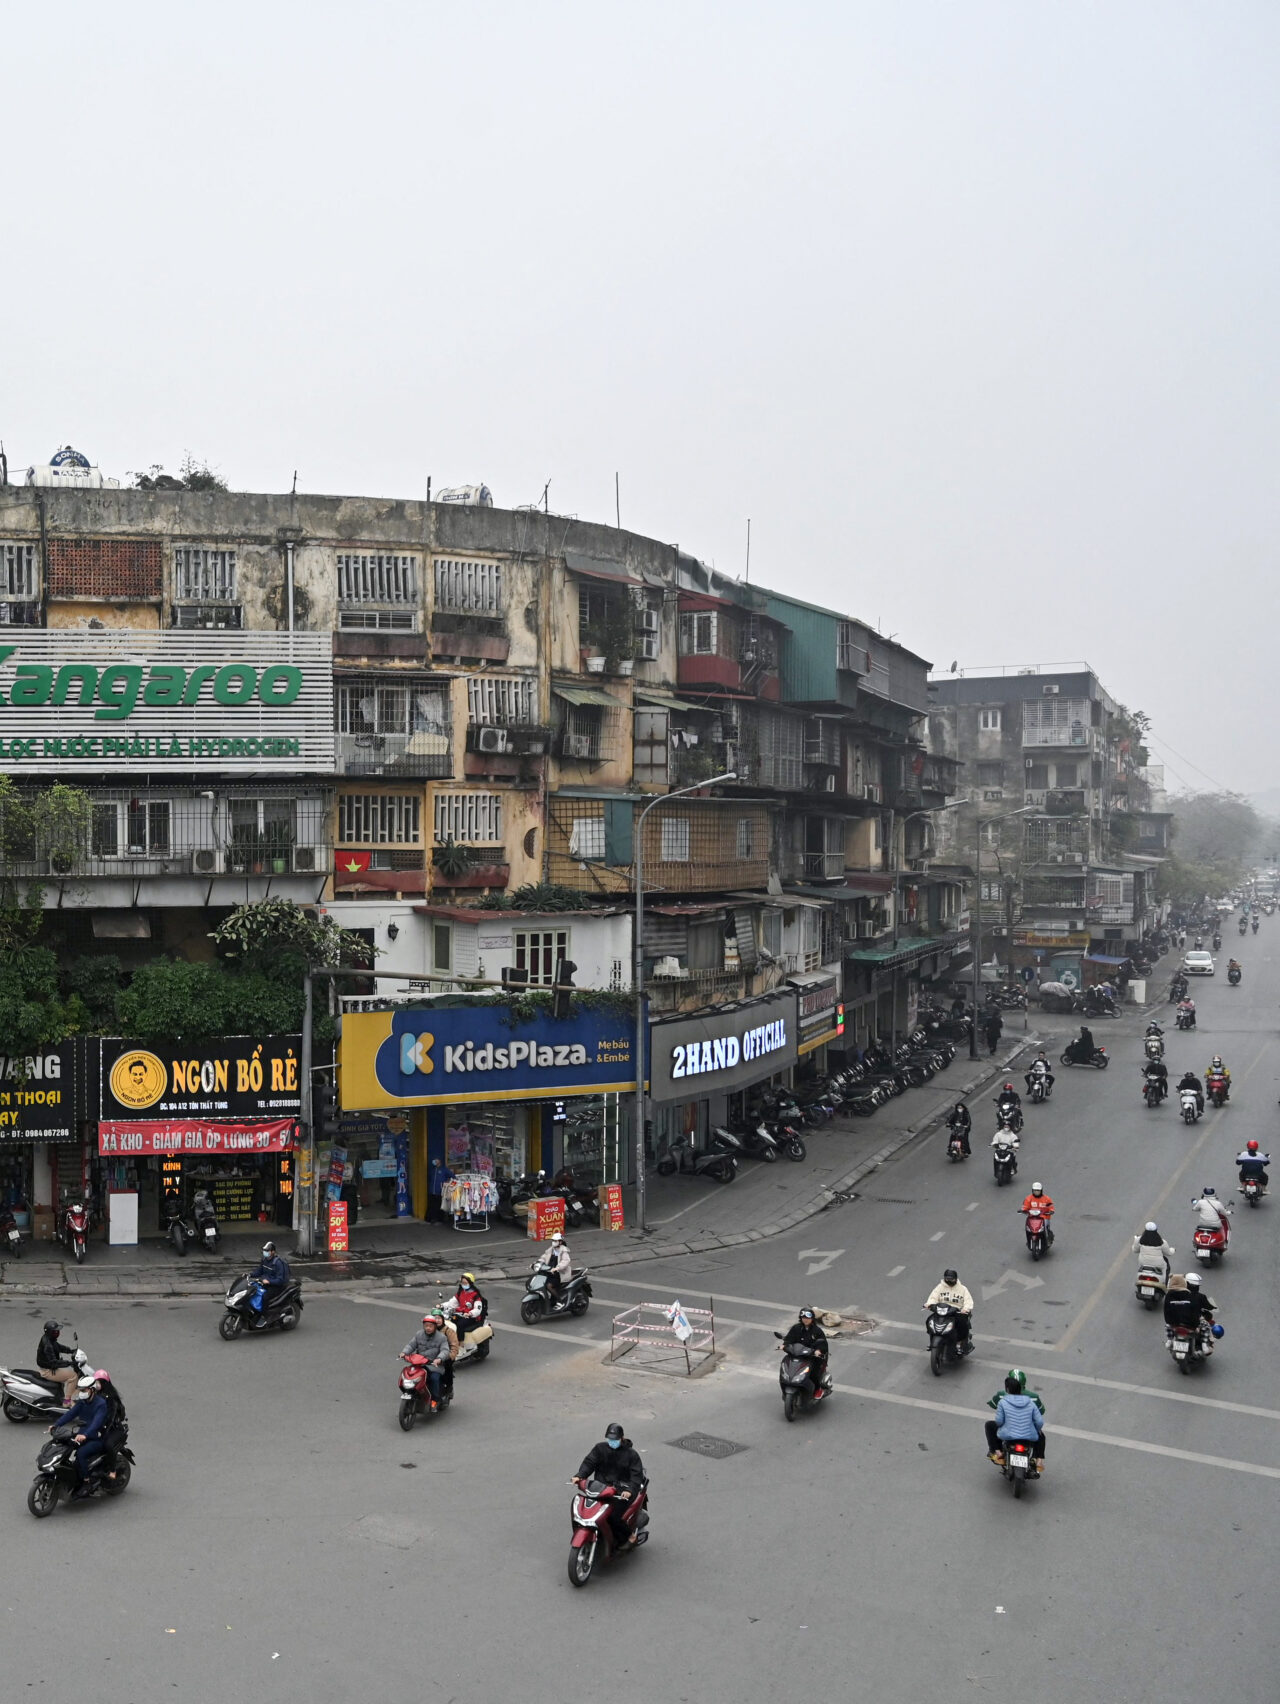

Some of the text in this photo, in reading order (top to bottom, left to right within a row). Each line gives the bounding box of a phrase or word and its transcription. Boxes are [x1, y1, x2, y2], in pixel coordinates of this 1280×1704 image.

[101, 731, 150, 757] PHẢI
[155, 732, 182, 757] LÀ
[188, 737, 300, 757] HYDROGEN
[598, 1041, 612, 1051] Mẹ
[672, 1036, 740, 1079] 2HAND
[743, 1018, 787, 1062] OFFICIAL
[172, 1044, 298, 1094] NGON BỔ RẺ
[13, 1090, 61, 1108] THOẠI
[102, 1126, 118, 1150] XẢ
[120, 1134, 143, 1150] KHO
[152, 1125, 182, 1150] GIẢM
[184, 1128, 204, 1149] GIÁ
[206, 1126, 221, 1148] ỐP
[224, 1131, 254, 1148] LƯNG
[256, 1131, 270, 1147] 30
[539, 1212, 565, 1223] XUÂN
